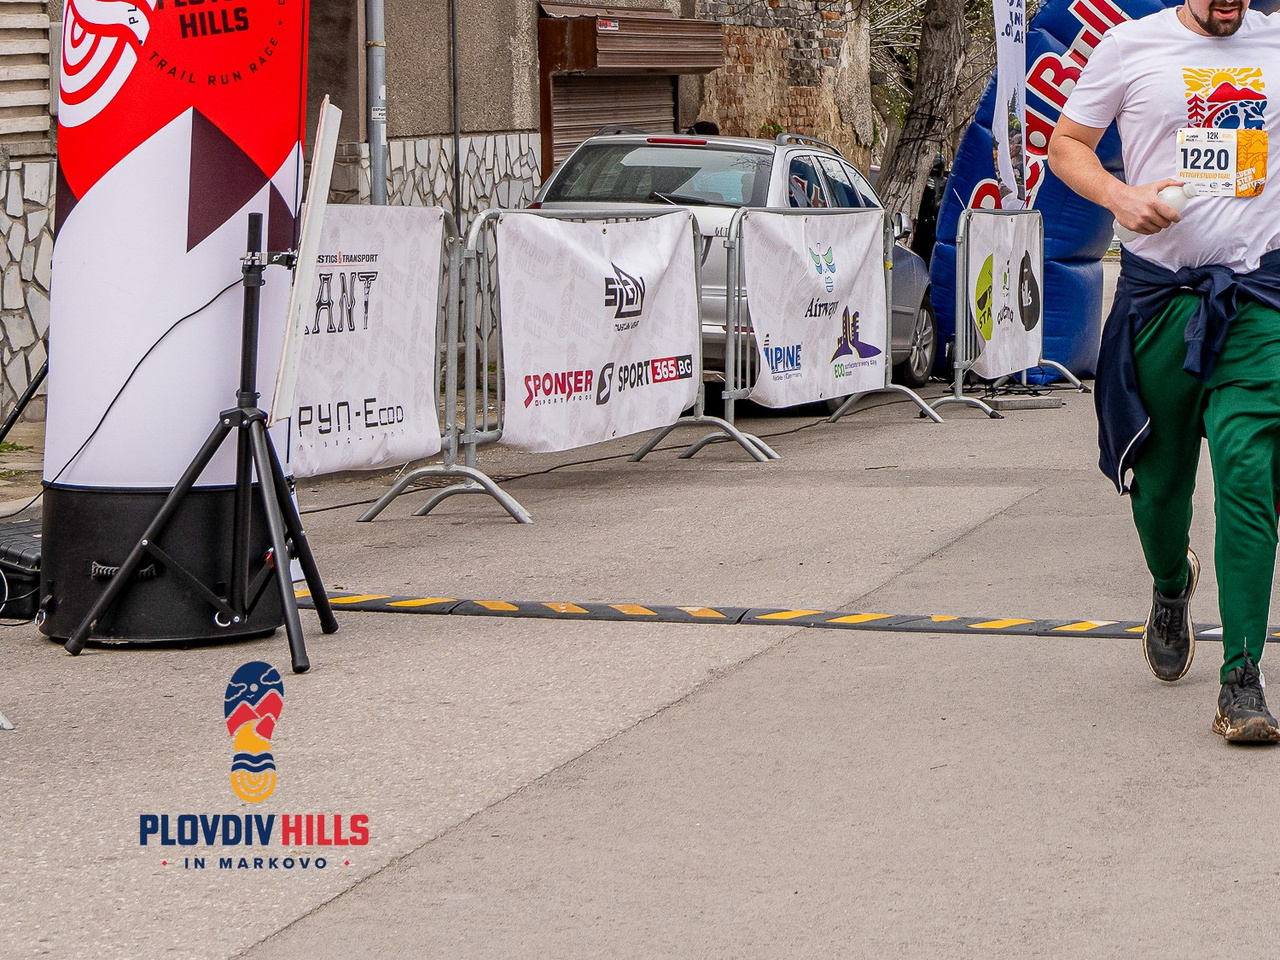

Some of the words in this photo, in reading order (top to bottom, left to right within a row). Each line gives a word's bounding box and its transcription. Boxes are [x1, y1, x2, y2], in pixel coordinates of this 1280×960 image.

[179, 7, 249, 39] HILLS
[149, 51, 196, 84] TRAIL
[208, 71, 242, 86] RUN
[249, 38, 278, 74] RACE
[1180, 148, 1229, 170] 1220
[342, 254, 378, 263] TRANSPORT
[304, 271, 378, 335] ANT
[524, 369, 593, 408] SPONSER
